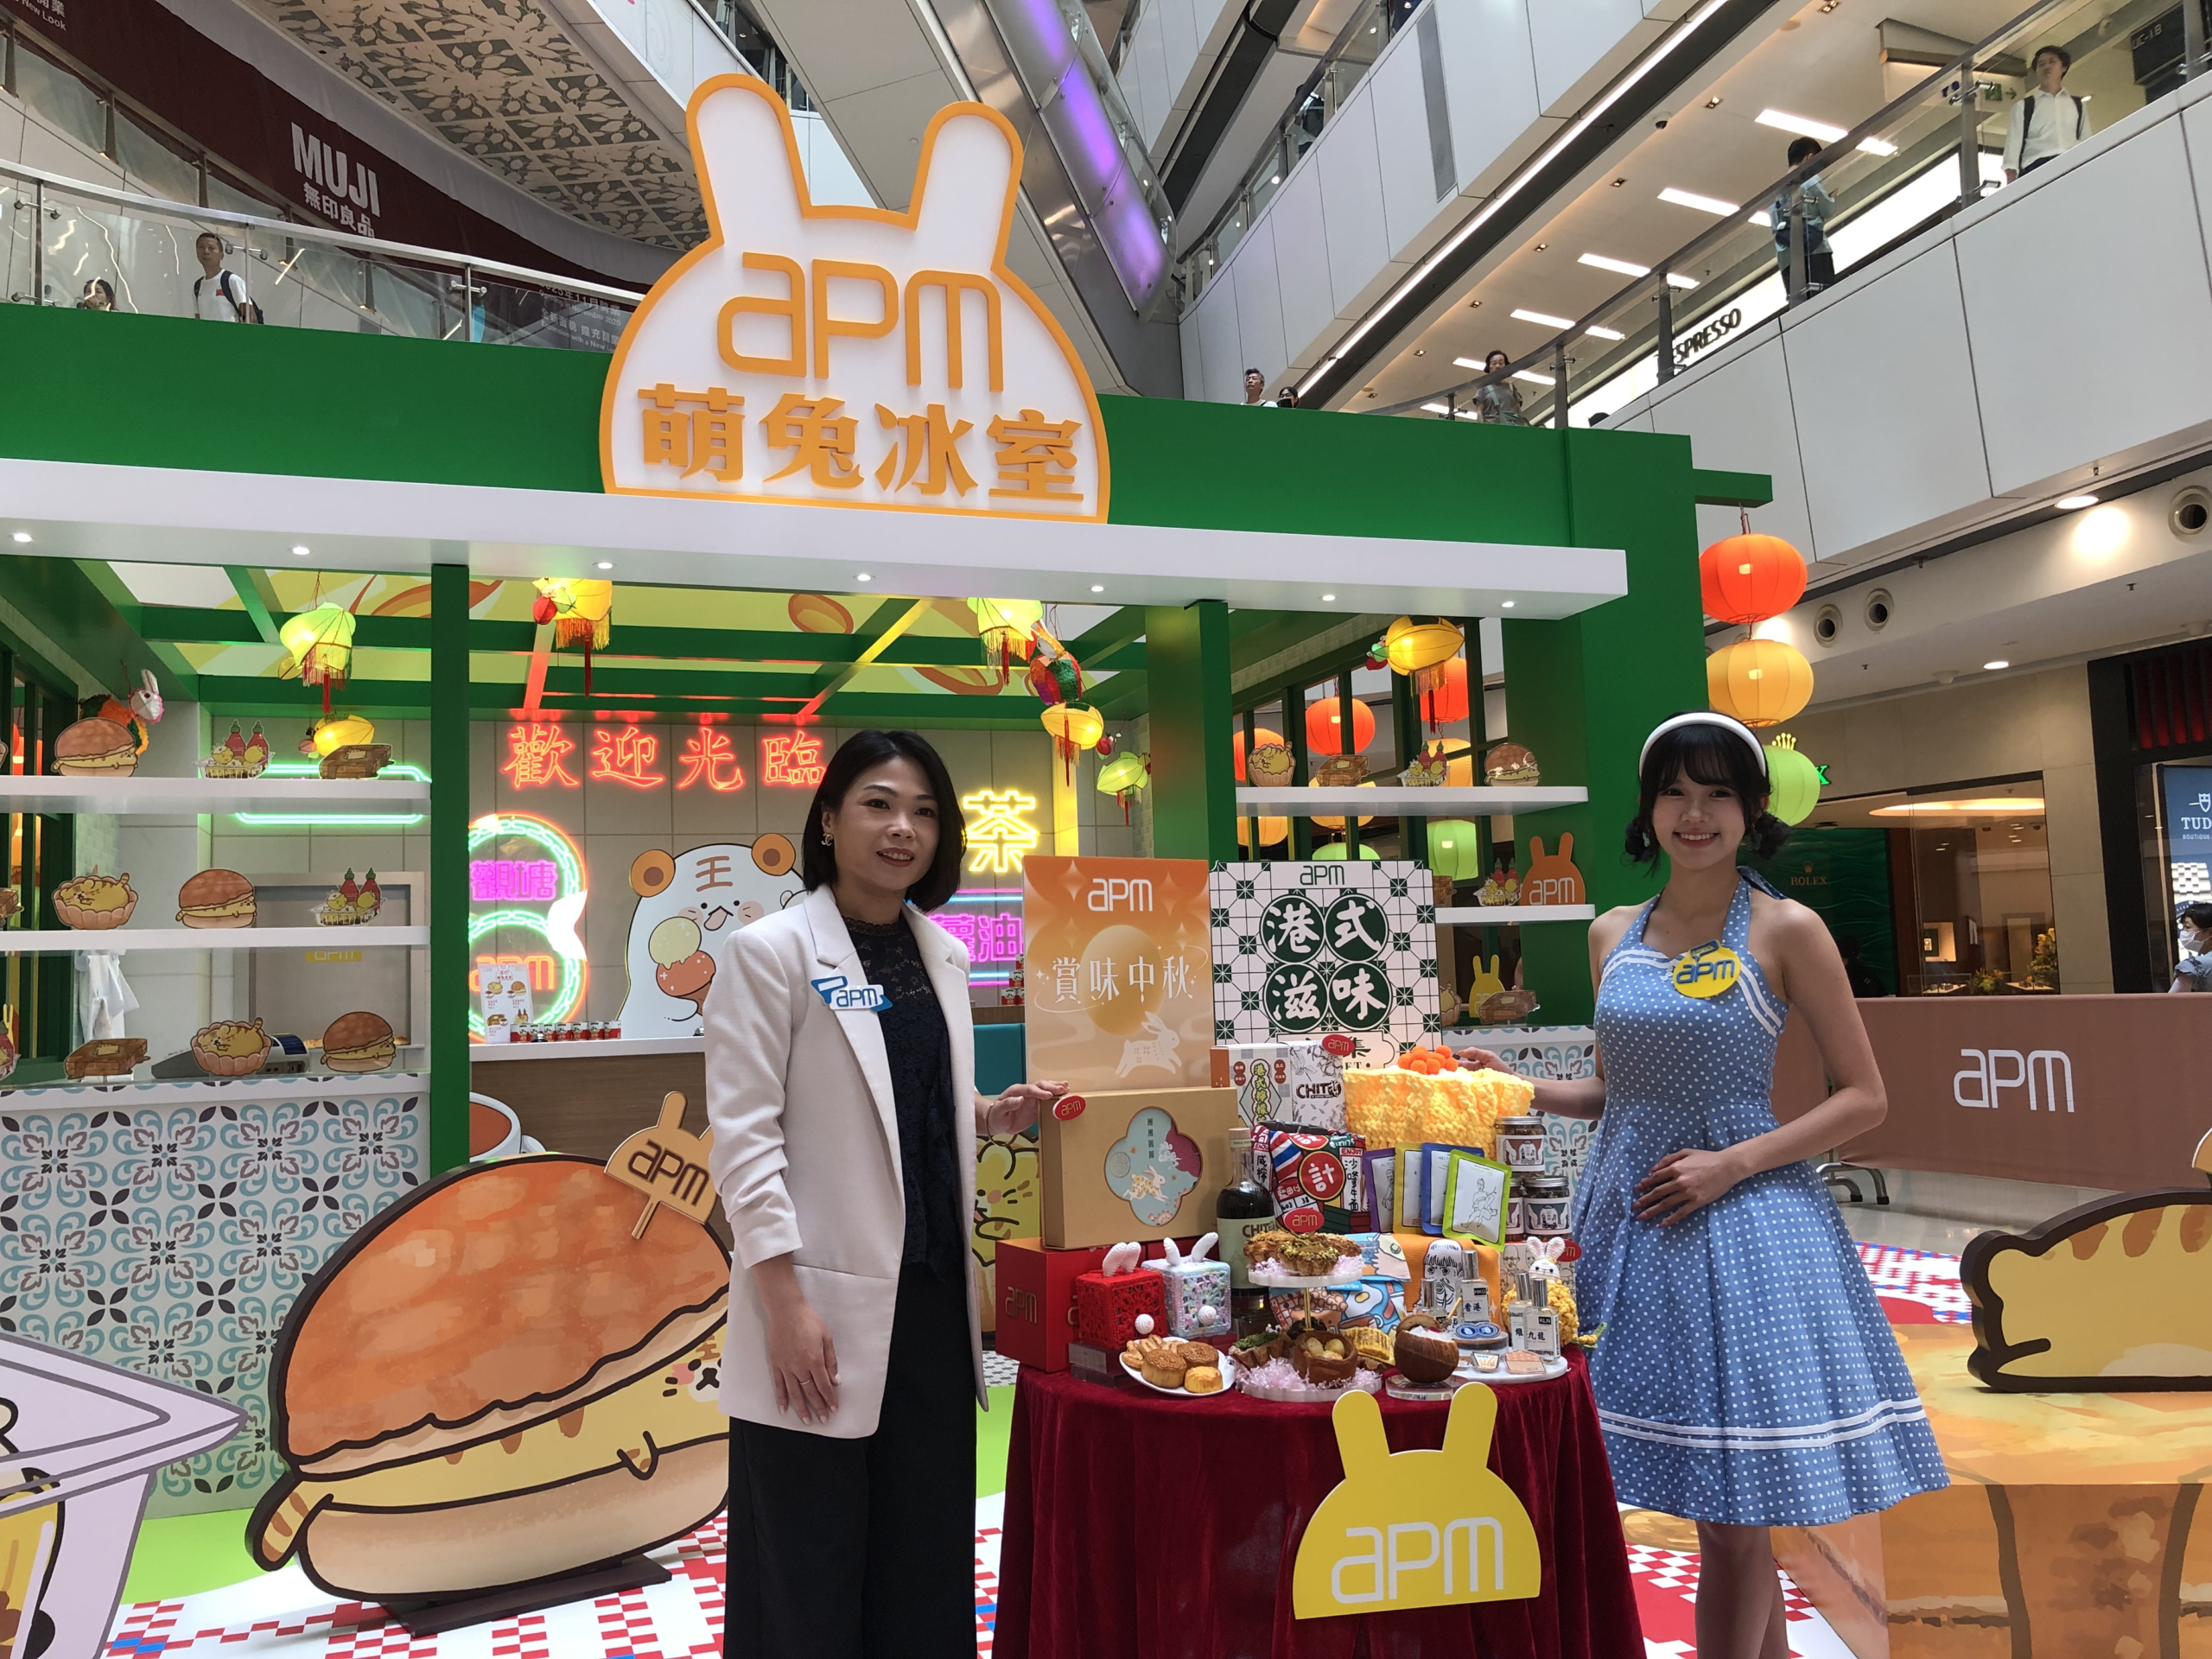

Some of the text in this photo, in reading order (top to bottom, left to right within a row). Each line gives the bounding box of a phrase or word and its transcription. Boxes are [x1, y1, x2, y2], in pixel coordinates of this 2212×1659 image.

[42, 10, 67, 31] Look
[291, 122, 380, 218] MUJI
[303, 181, 375, 238] 無印良品
[1654, 308, 1742, 364] SPRESSO
[638, 383, 1084, 501] 萌兔冰室
[504, 723, 825, 791] 歡迎光臨
[963, 790, 1039, 874] 茶
[1790, 876, 1827, 886] ROLEX
[1266, 899, 1382, 953] 港式
[1052, 954, 1194, 1005] 賞味中秋
[1271, 968, 1387, 1020] 滋味
[1464, 1302, 1482, 1313] 香港
[1528, 1331, 1546, 1341] 九龍
